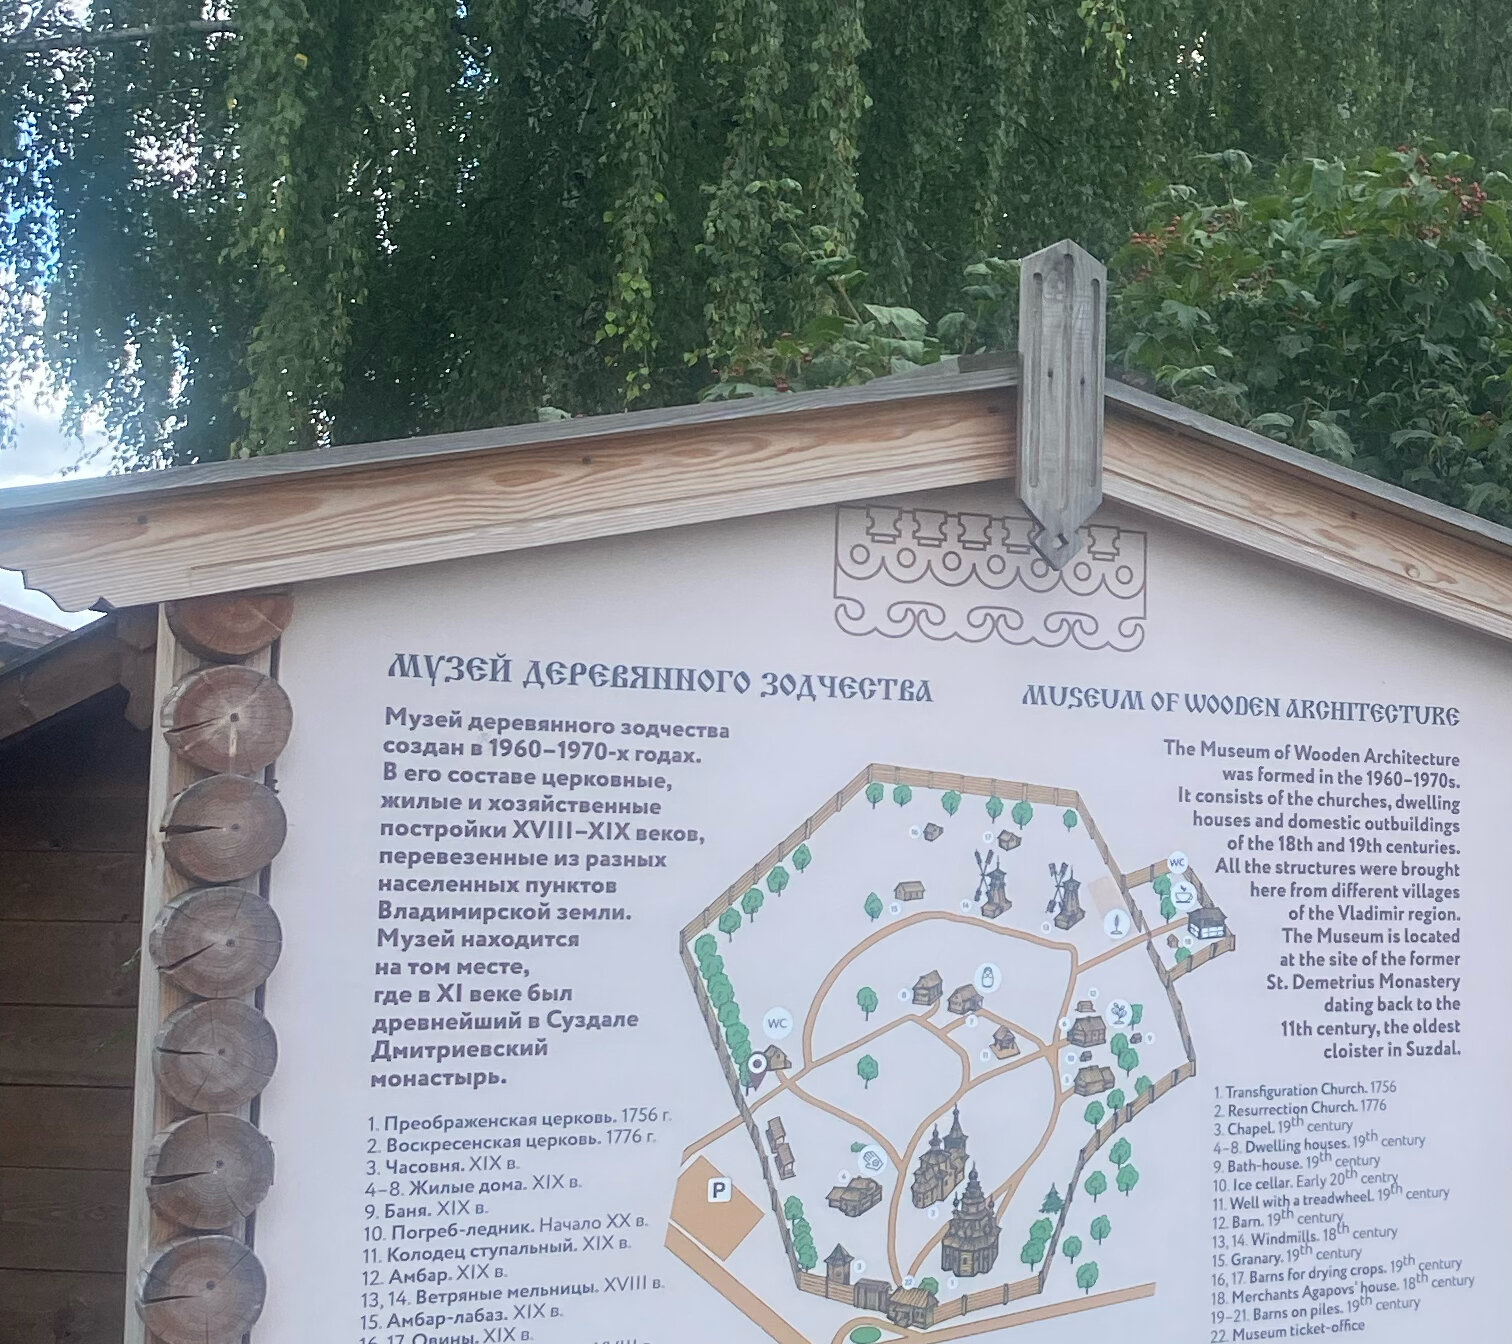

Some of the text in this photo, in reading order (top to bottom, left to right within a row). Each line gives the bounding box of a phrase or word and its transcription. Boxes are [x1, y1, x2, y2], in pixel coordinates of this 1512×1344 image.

[387, 652, 934, 702] МУЗЕЙ ДЕРЕВЯННОГО ЗОДЧЕСТВА
[1022, 684, 1460, 726] MUSEUM OF WOODEN ARCHITECTURE
[385, 707, 729, 738] Музей деревянного зодчества
[383, 740, 464, 757] создан
[470, 743, 483, 756] в
[635, 749, 701, 765] годах.
[1164, 739, 1460, 766] The Museum of Wooden Architecture
[383, 761, 672, 791] В его составе церковные,
[1222, 770, 1254, 781] was
[1257, 765, 1315, 784] formed
[1319, 768, 1333, 784] in
[1337, 769, 1363, 785] the
[380, 794, 661, 814] жилые и хозяйственные
[1179, 786, 1460, 814] It consists of the churches, dwelling
[380, 819, 506, 842] постройки
[636, 828, 704, 845] веков,
[1193, 810, 1460, 836] houses and domestic outbuildings
[1227, 834, 1460, 854] of the 18th and 19th centuries.
[379, 851, 667, 871] перевезенные из разных
[1169, 858, 1185, 867] WC
[1215, 857, 1460, 880] All the structures were brought
[378, 878, 617, 898] населенных пунктов
[1250, 881, 1460, 903] here from different villages
[378, 900, 631, 925] Владимирской земли.
[1288, 904, 1460, 925] of the Vladimir region.
[377, 927, 579, 952] Музей находится
[1281, 927, 1460, 944] The Museum is located
[375, 962, 529, 977] на том месте,
[1267, 972, 1460, 992] St. Demetrius Monastery
[374, 983, 572, 1006] где в XI веке был
[371, 1009, 639, 1036] древнейший в Суздале
[768, 1018, 788, 1029] WC
[1281, 1017, 1461, 1039] 11th century, the oldest
[370, 1037, 548, 1063] Дмитриевский
[1324, 1039, 1461, 1059] cloister in Suzdal.
[371, 1072, 507, 1090] монастырь.
[1225, 1084, 1318, 1099] Transfiguration
[1321, 1081, 1368, 1095] Church.
[1370, 1080, 1396, 1093] 1756
[1228, 1102, 1308, 1117] Resurrection
[1310, 1099, 1358, 1114] Church.
[1360, 1098, 1387, 1111] 1776
[384, 1114, 537, 1134] Преображенская
[541, 1113, 617, 1128] церковь.
[621, 1107, 658, 1122] 1756
[712, 1182, 726, 1199] P
[1232, 1327, 1287, 1341] Museum
[1289, 1319, 1365, 1336] ticket-office
